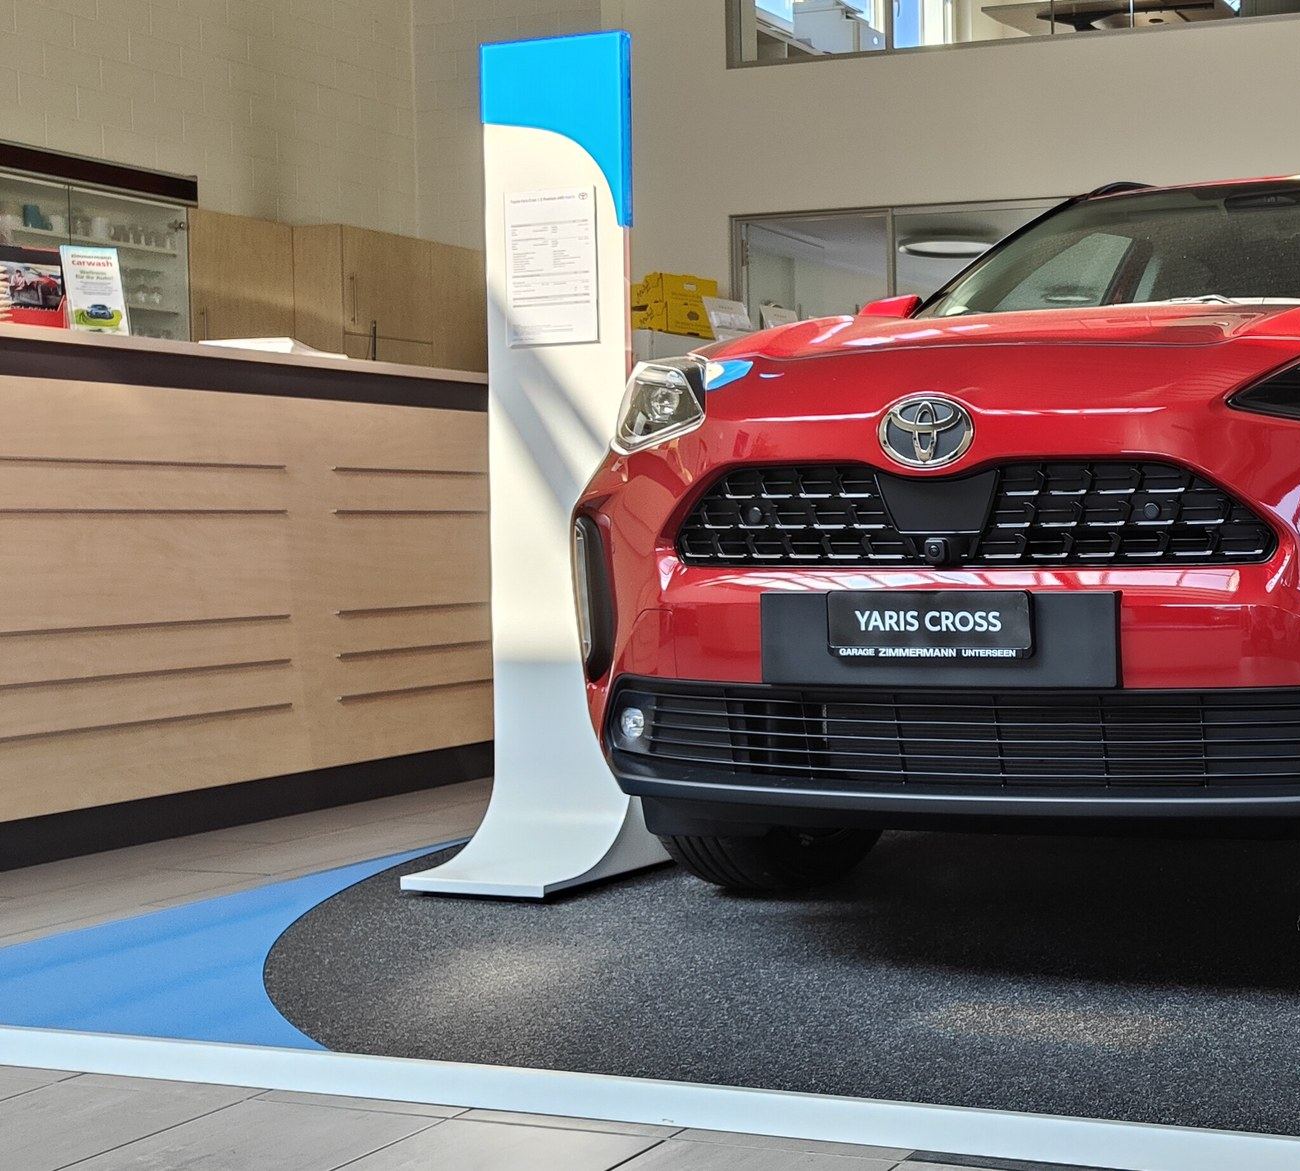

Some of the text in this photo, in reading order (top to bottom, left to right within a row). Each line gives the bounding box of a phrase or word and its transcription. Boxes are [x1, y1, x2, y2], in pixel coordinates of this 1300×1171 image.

[854, 610, 1002, 632] YARIS CROSS
[839, 648, 1016, 657] GARAGE ZIMMERMANN UNTERSEEN
